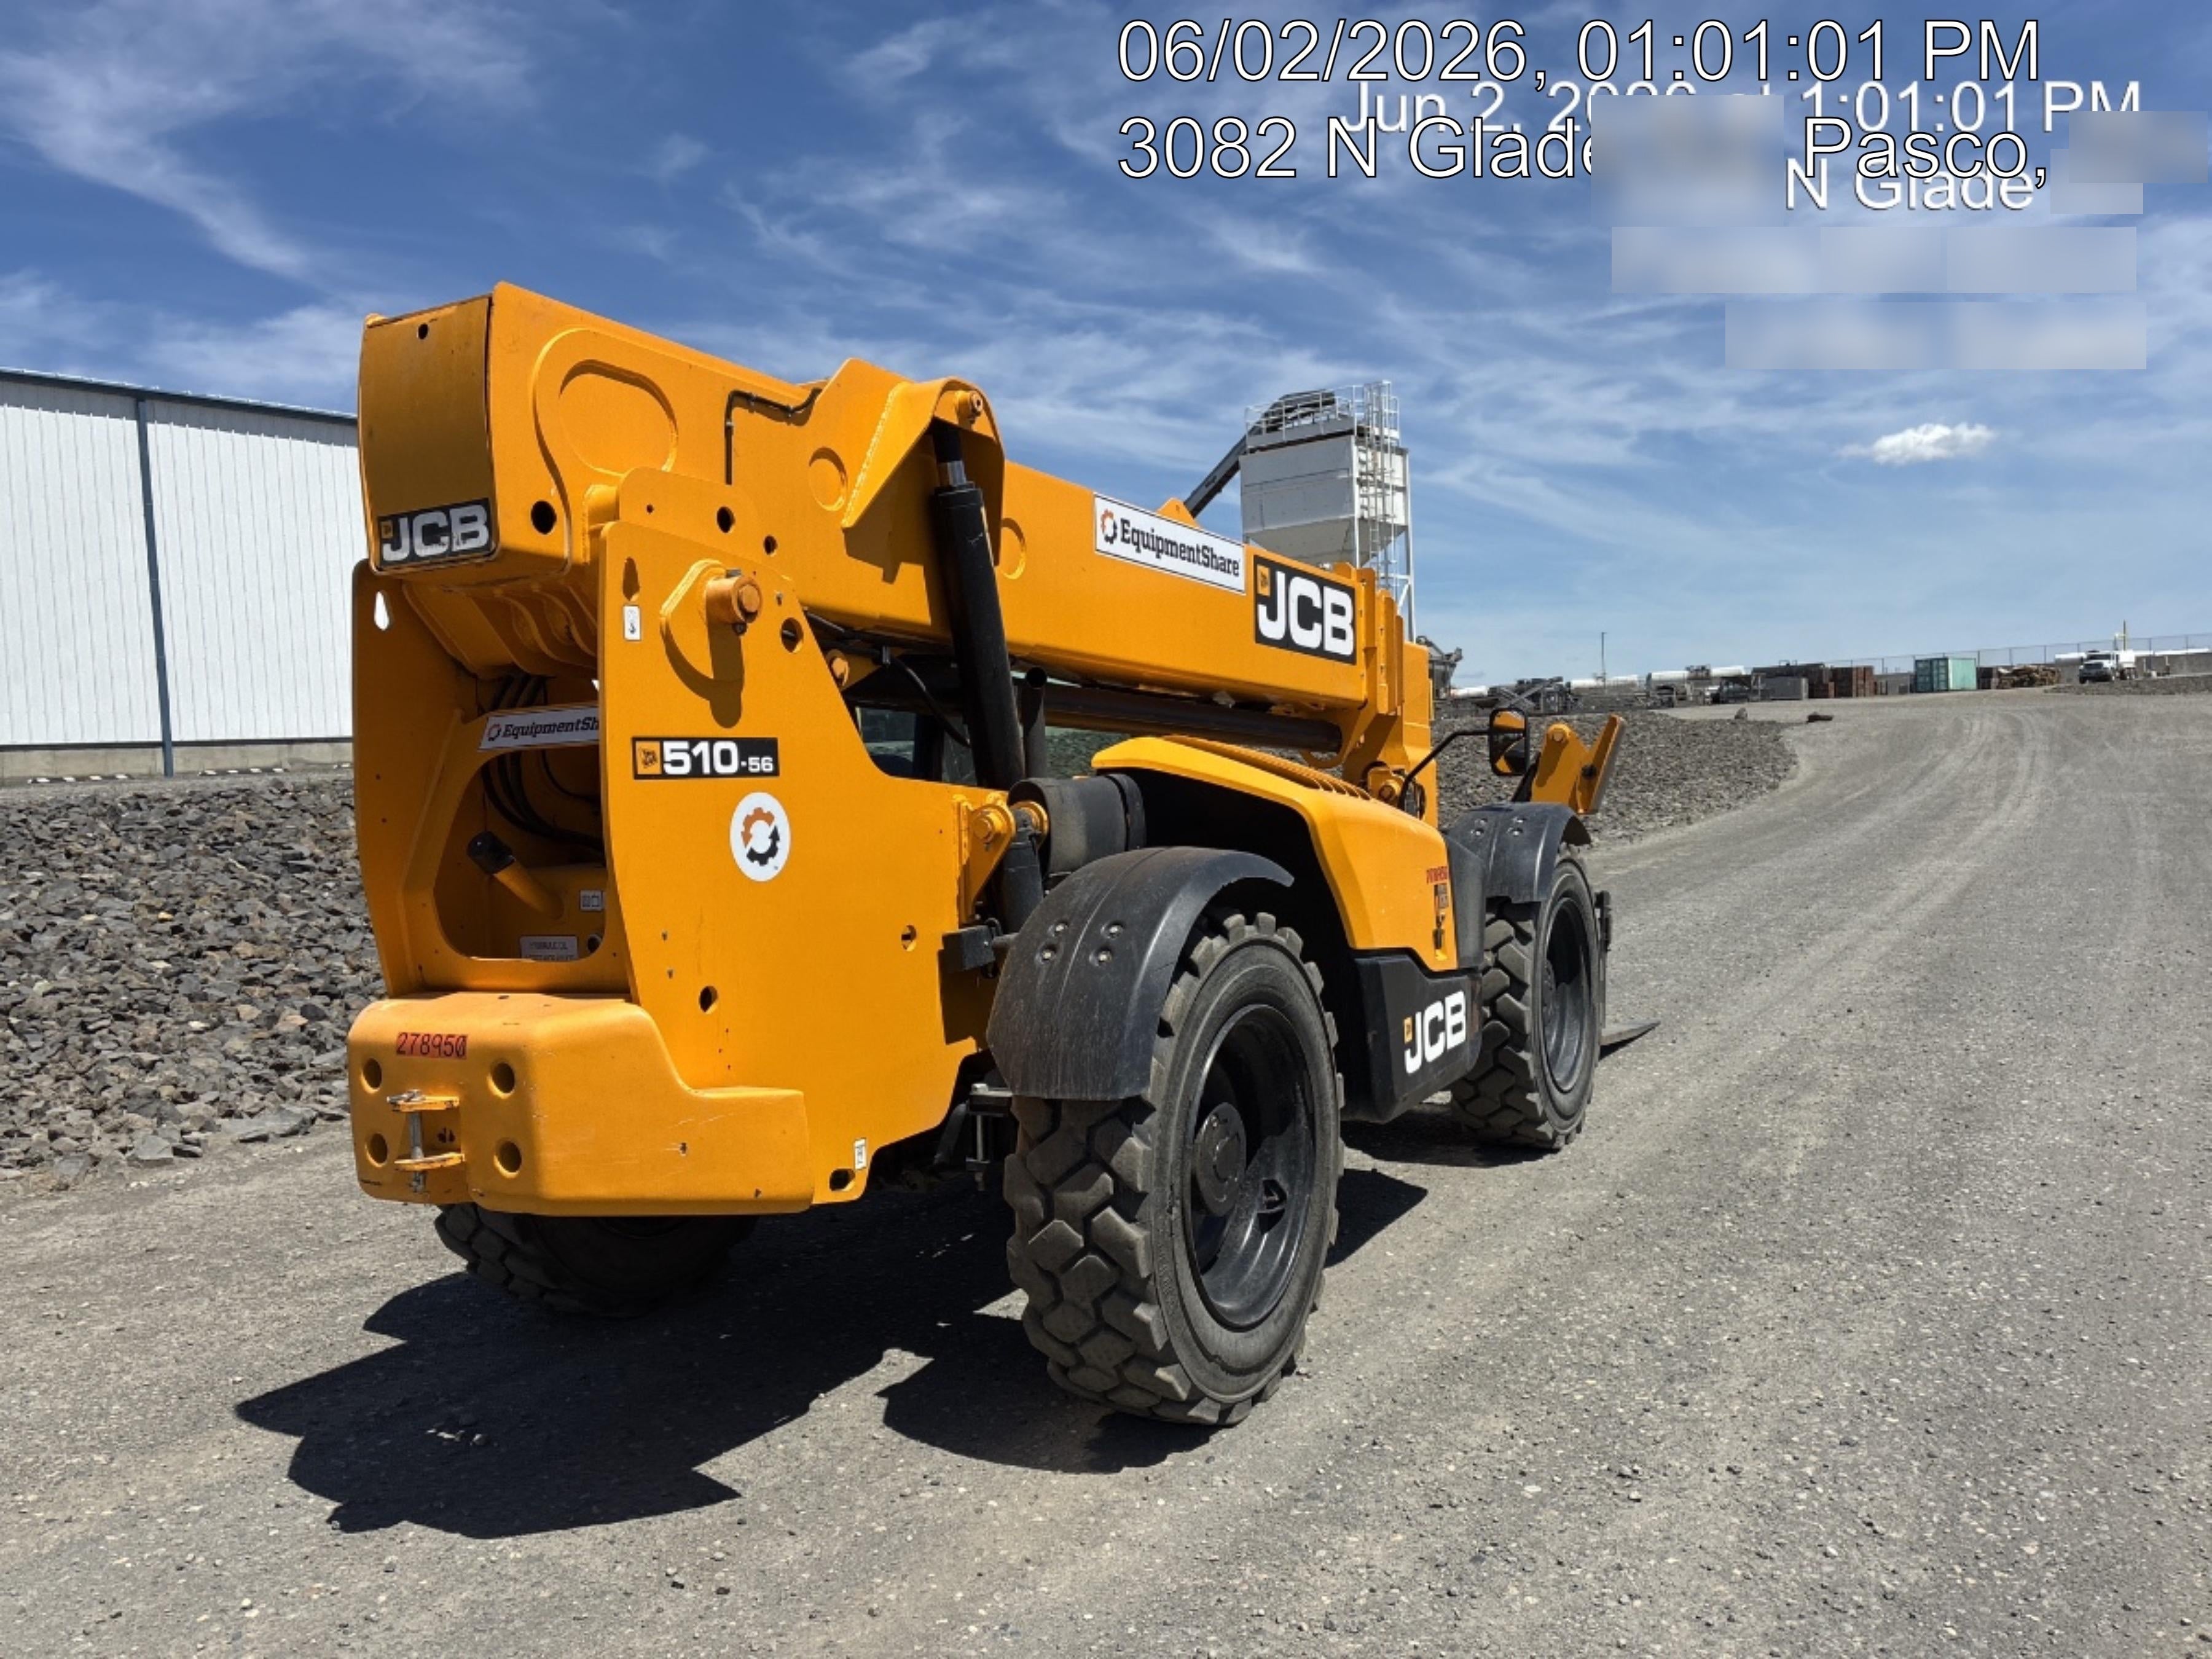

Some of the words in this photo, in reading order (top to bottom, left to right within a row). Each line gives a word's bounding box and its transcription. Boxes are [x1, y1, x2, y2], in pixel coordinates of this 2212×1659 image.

[382, 504, 489, 562] JCB
[1120, 517, 1240, 577] EquipmentShare
[1258, 570, 1354, 656] JCB
[503, 716, 599, 739] EquipmentSh
[396, 1032, 466, 1057] 278950
[1404, 989, 1466, 1074] JCB
